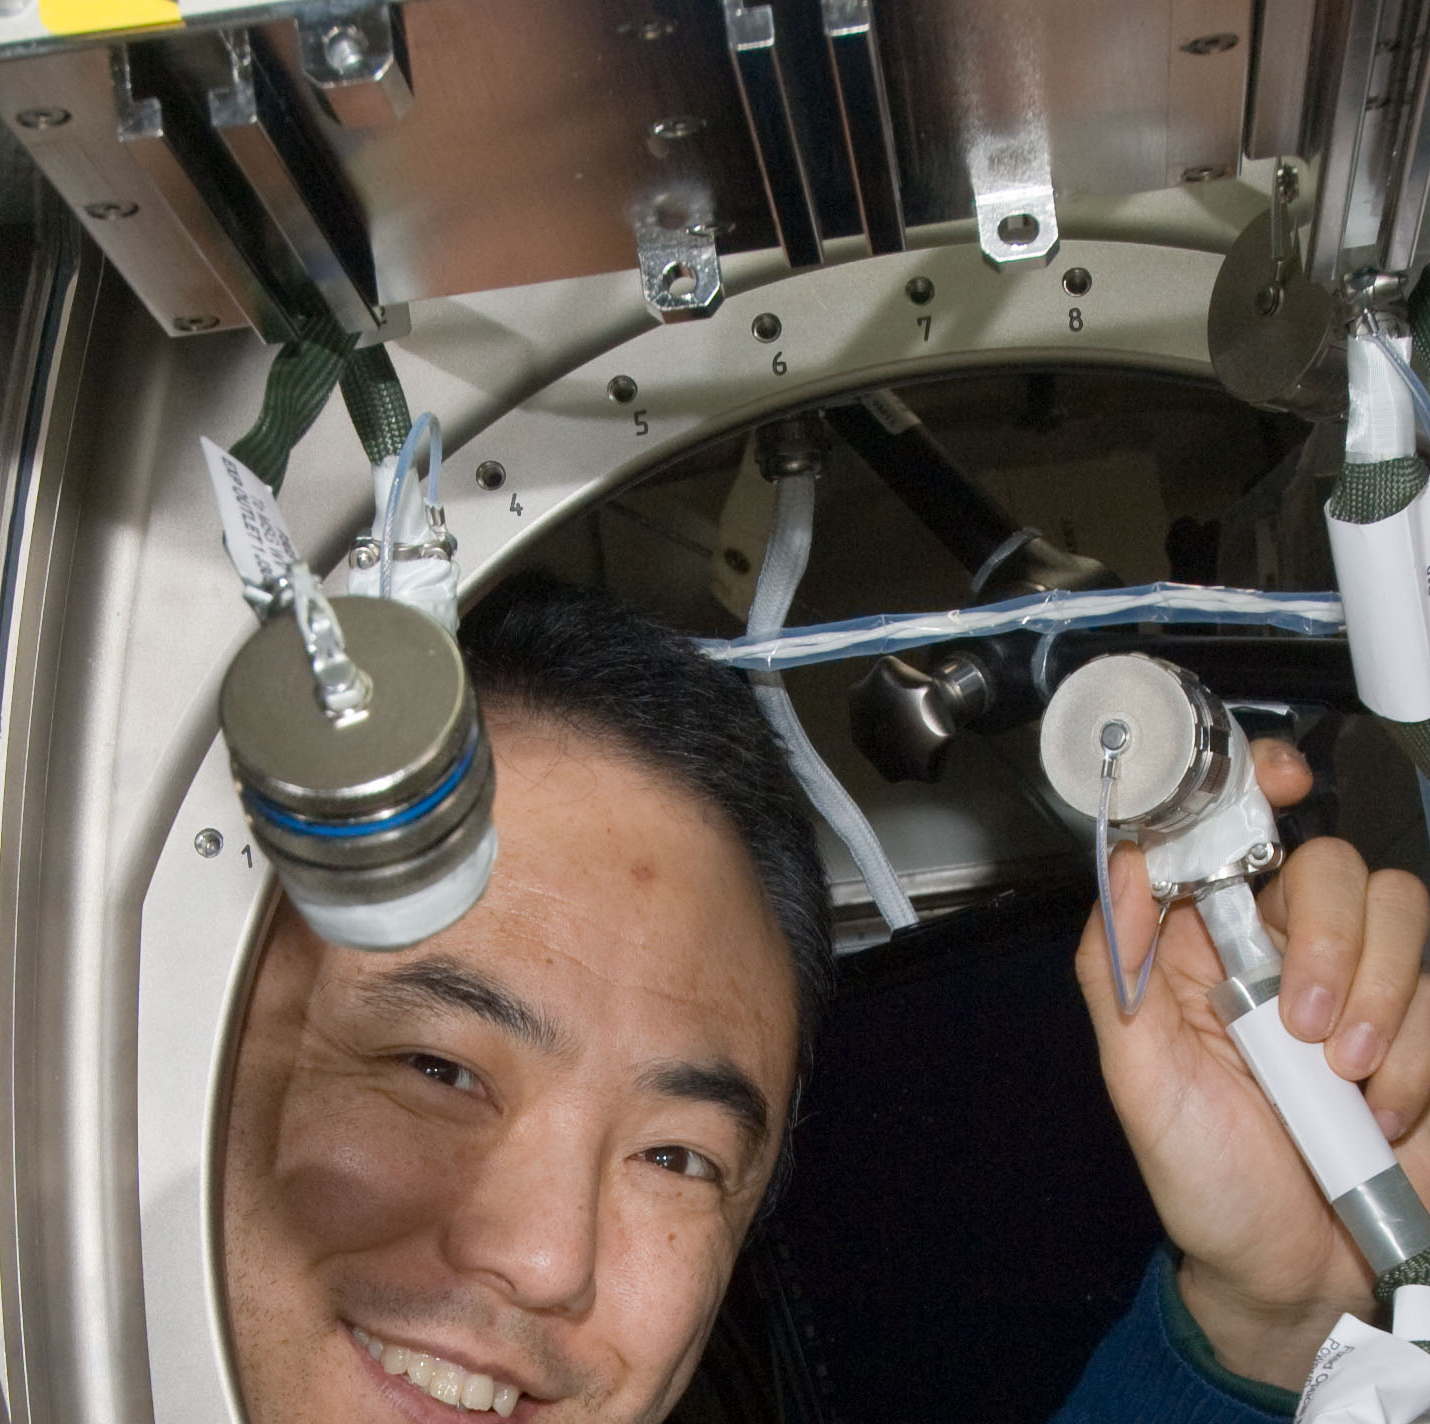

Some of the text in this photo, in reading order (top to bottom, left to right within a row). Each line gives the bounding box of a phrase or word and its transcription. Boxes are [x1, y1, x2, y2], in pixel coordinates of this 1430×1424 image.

[916, 315, 932, 341] 7
[1067, 307, 1085, 334] 8
[771, 351, 788, 377] 6
[630, 408, 649, 436] 5
[222, 455, 244, 488] EXP
[232, 484, 263, 545] OUTLET
[509, 492, 524, 517] 4
[241, 843, 253, 869] 1
